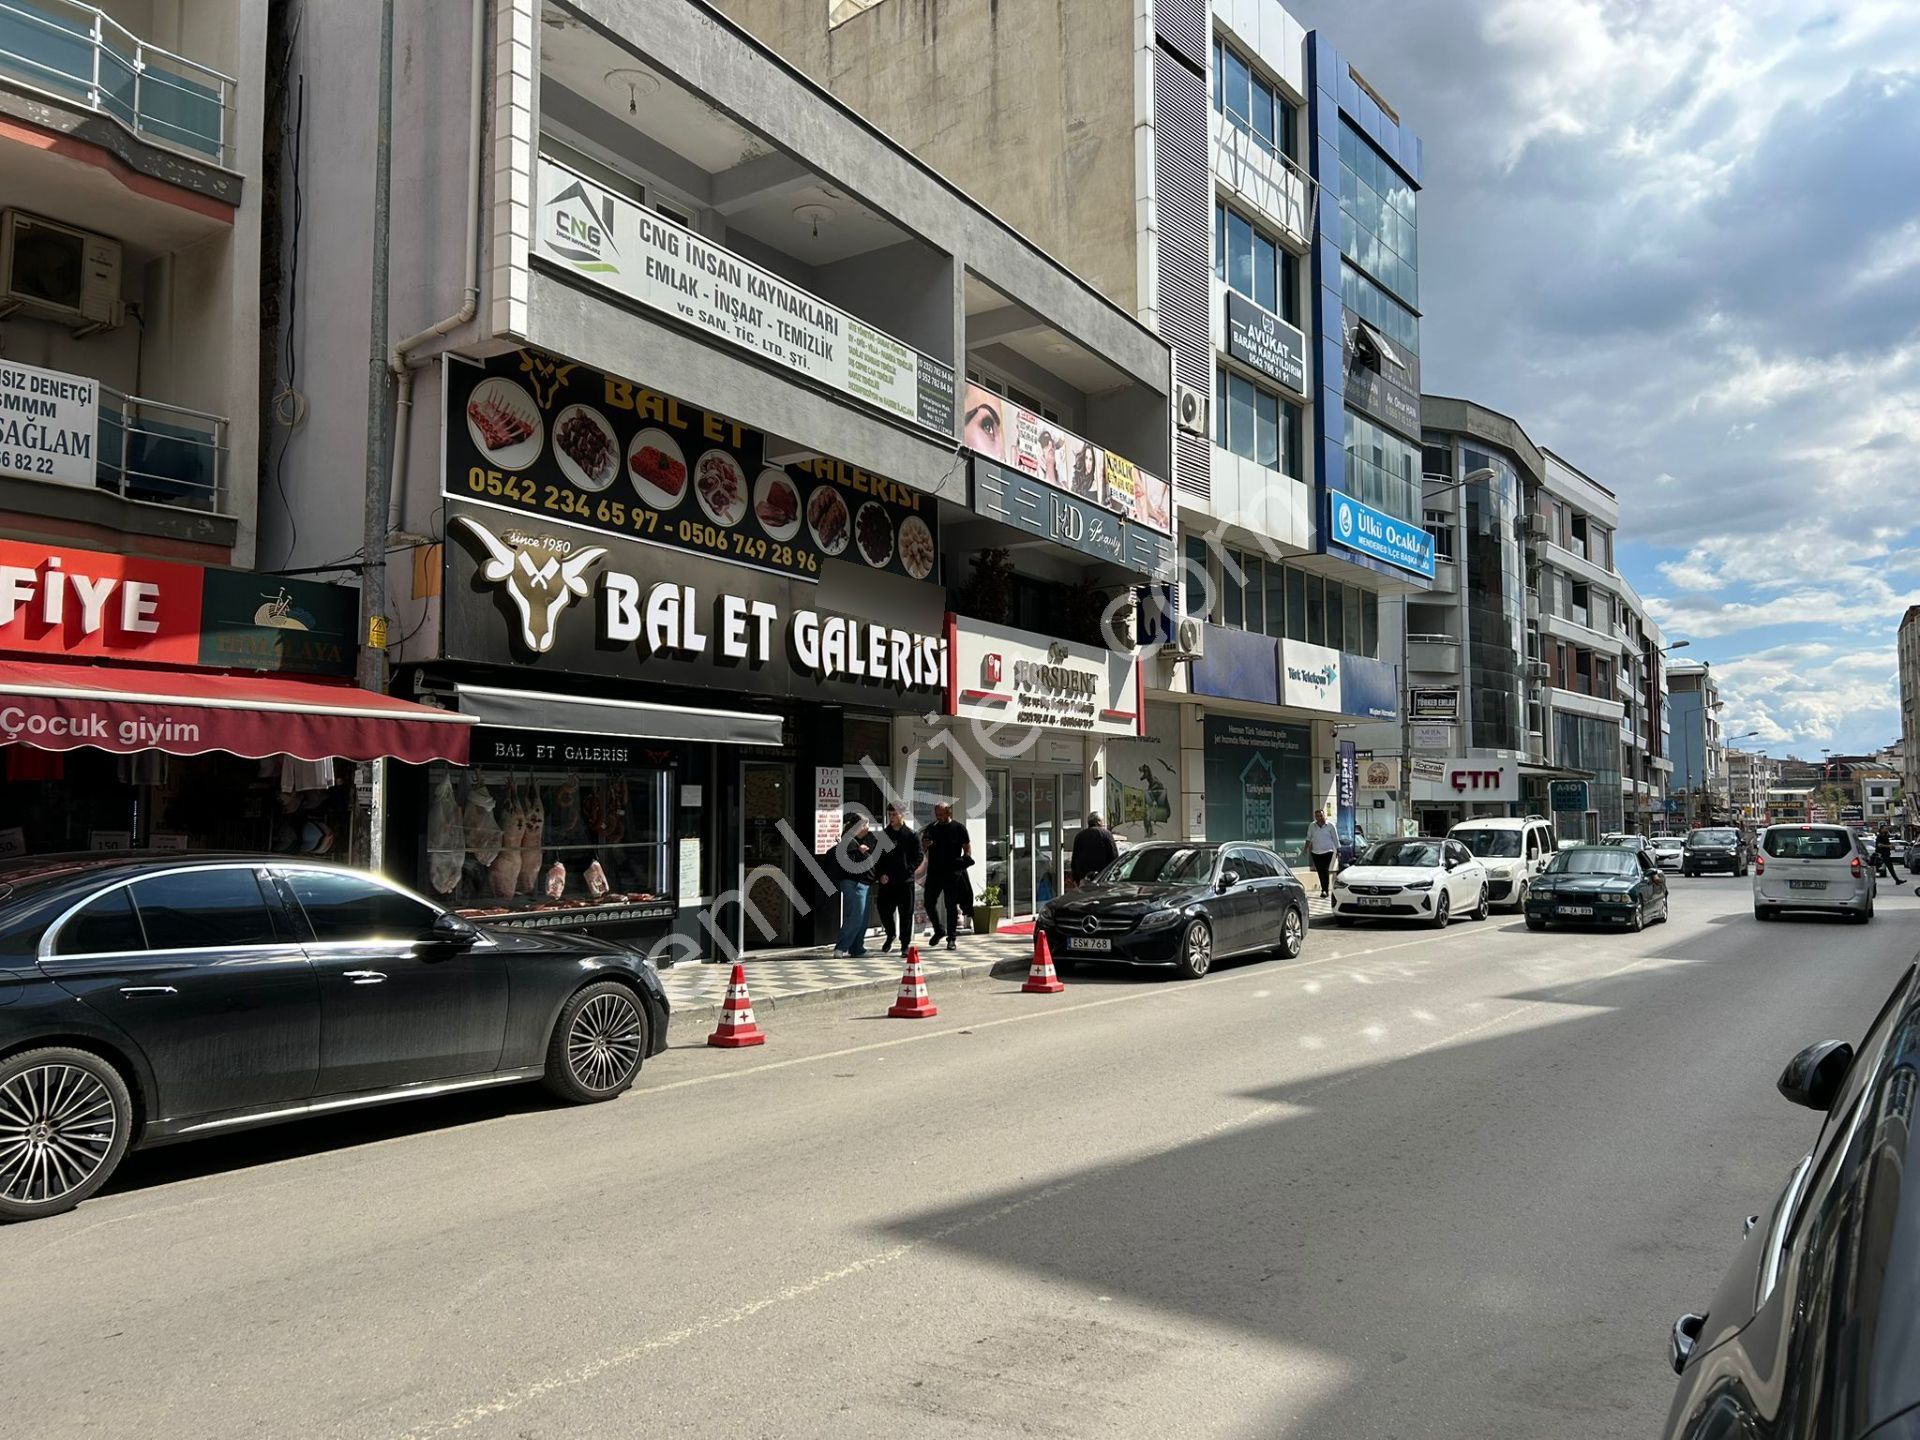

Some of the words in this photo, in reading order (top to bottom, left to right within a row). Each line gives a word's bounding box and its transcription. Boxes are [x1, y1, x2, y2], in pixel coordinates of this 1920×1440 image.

[556, 210, 600, 246] CNG
[639, 218, 679, 257] CNG
[685, 236, 741, 288] İNSAN
[747, 272, 838, 336] KAYNAKLARI
[646, 256, 698, 299] EMLAK
[714, 283, 763, 328] İNŞAAT
[776, 319, 833, 362] TEMİZLİK
[676, 302, 694, 317] ve
[698, 309, 730, 333] SAN.
[735, 326, 758, 346] TİC.
[762, 338, 786, 358] LTD.
[789, 351, 811, 370] ŞTİ.
[1233, 331, 1257, 353] BARAN
[1248, 323, 1289, 358] AVUKAT
[0, 368, 26, 391] SIZ
[30, 375, 92, 407] DENETÇİ
[0, 392, 57, 418] MMM
[604, 374, 688, 430] BAL
[703, 410, 750, 449] ET
[0, 450, 10, 467] 6
[14, 453, 32, 471] 82
[36, 457, 54, 475] 22
[468, 466, 537, 505] 0542
[544, 485, 591, 518] 234
[596, 499, 625, 526] 65
[631, 508, 659, 534] 97
[679, 520, 728, 550] 0506
[733, 532, 767, 559] 749
[771, 544, 792, 567] 28
[796, 550, 817, 573] 96
[1358, 509, 1382, 539] Ülkü
[510, 532, 540, 547] since
[542, 537, 571, 554] 1980
[0, 556, 160, 634] FİYE
[605, 571, 707, 653] BAL
[723, 594, 778, 661] ET
[793, 609, 948, 689] GALERİSİ
[1288, 667, 1301, 681] Türk
[1301, 670, 1326, 685] Telekom
[0, 707, 108, 739] Çocuk
[119, 716, 199, 745] giyim
[495, 743, 525, 758] BAL
[536, 745, 555, 759] ET
[1415, 761, 1444, 773] Toprak
[818, 787, 840, 798] BAL
[1091, 939, 1108, 948] 768
